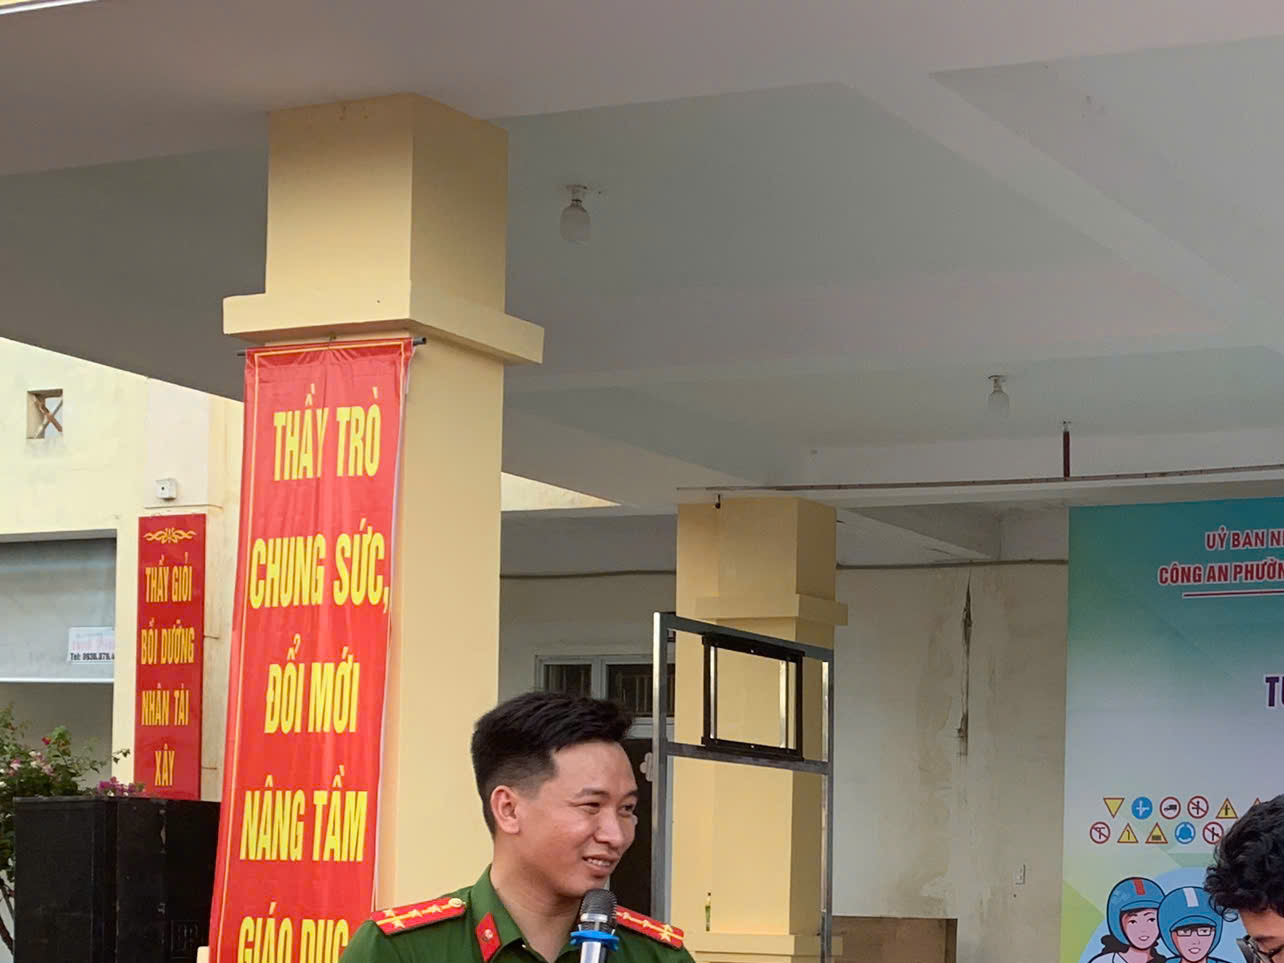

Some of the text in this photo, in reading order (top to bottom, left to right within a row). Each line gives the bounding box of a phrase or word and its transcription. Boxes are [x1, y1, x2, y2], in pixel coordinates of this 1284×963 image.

[274, 383, 381, 481] THẦY TRÒ
[250, 518, 390, 614] CHUNG SỨC,
[1159, 562, 1202, 584] CÔNG
[1206, 564, 1229, 583] AN
[1231, 530, 1265, 548] BAN
[141, 682, 169, 726] NHÂN
[264, 633, 360, 734] ĐỔI MỚI
[154, 743, 175, 786] XÂY
[240, 765, 368, 862] NÂNG TẦM
